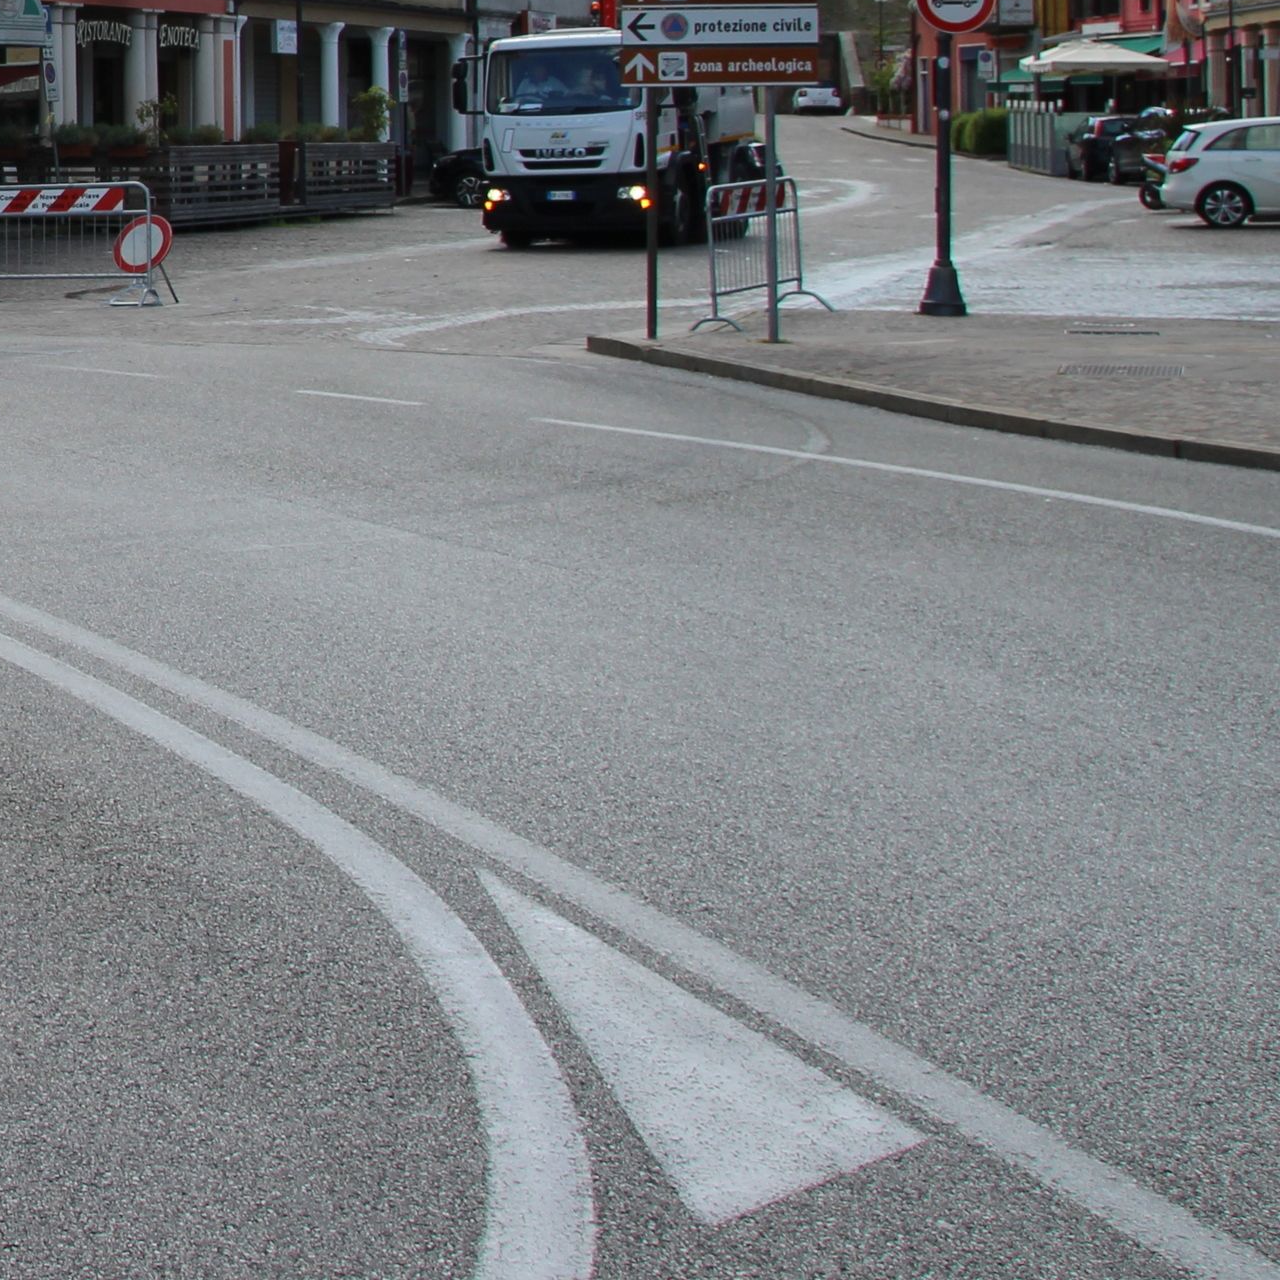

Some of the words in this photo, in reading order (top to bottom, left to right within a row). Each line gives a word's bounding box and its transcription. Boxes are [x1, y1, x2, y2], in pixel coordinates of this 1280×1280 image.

[77, 19, 133, 48] RISTORANTE
[694, 19, 767, 35] protezione
[773, 17, 812, 32] civile
[159, 24, 201, 49] ENOTECA
[693, 62, 724, 73] zona
[728, 57, 813, 74] archeologica
[535, 148, 586, 158] IVECO
